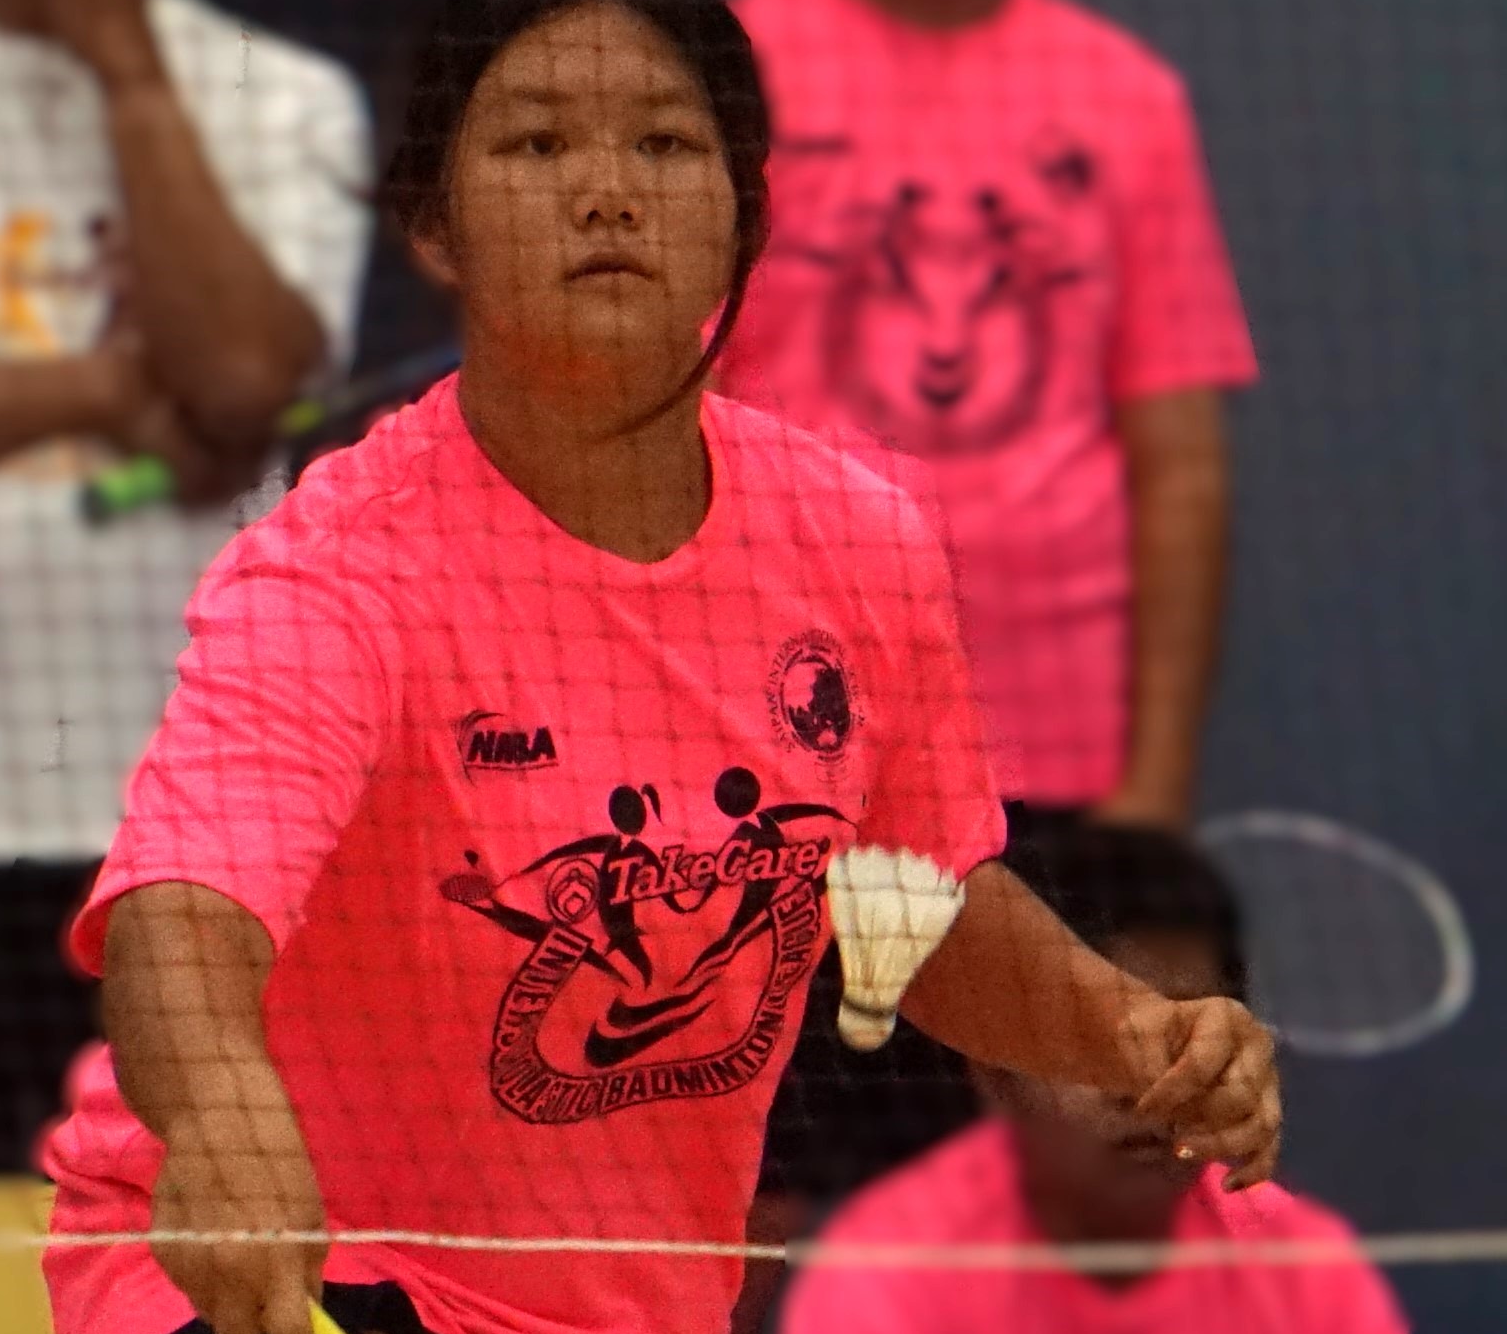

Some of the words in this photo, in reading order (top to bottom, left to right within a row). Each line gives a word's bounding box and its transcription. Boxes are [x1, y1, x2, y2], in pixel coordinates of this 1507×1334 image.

[466, 725, 557, 764] NMBA
[607, 839, 824, 906] TakeCare
[496, 931, 600, 1121] INTERSOLASTIC
[604, 1009, 785, 1107] BADMINTON
